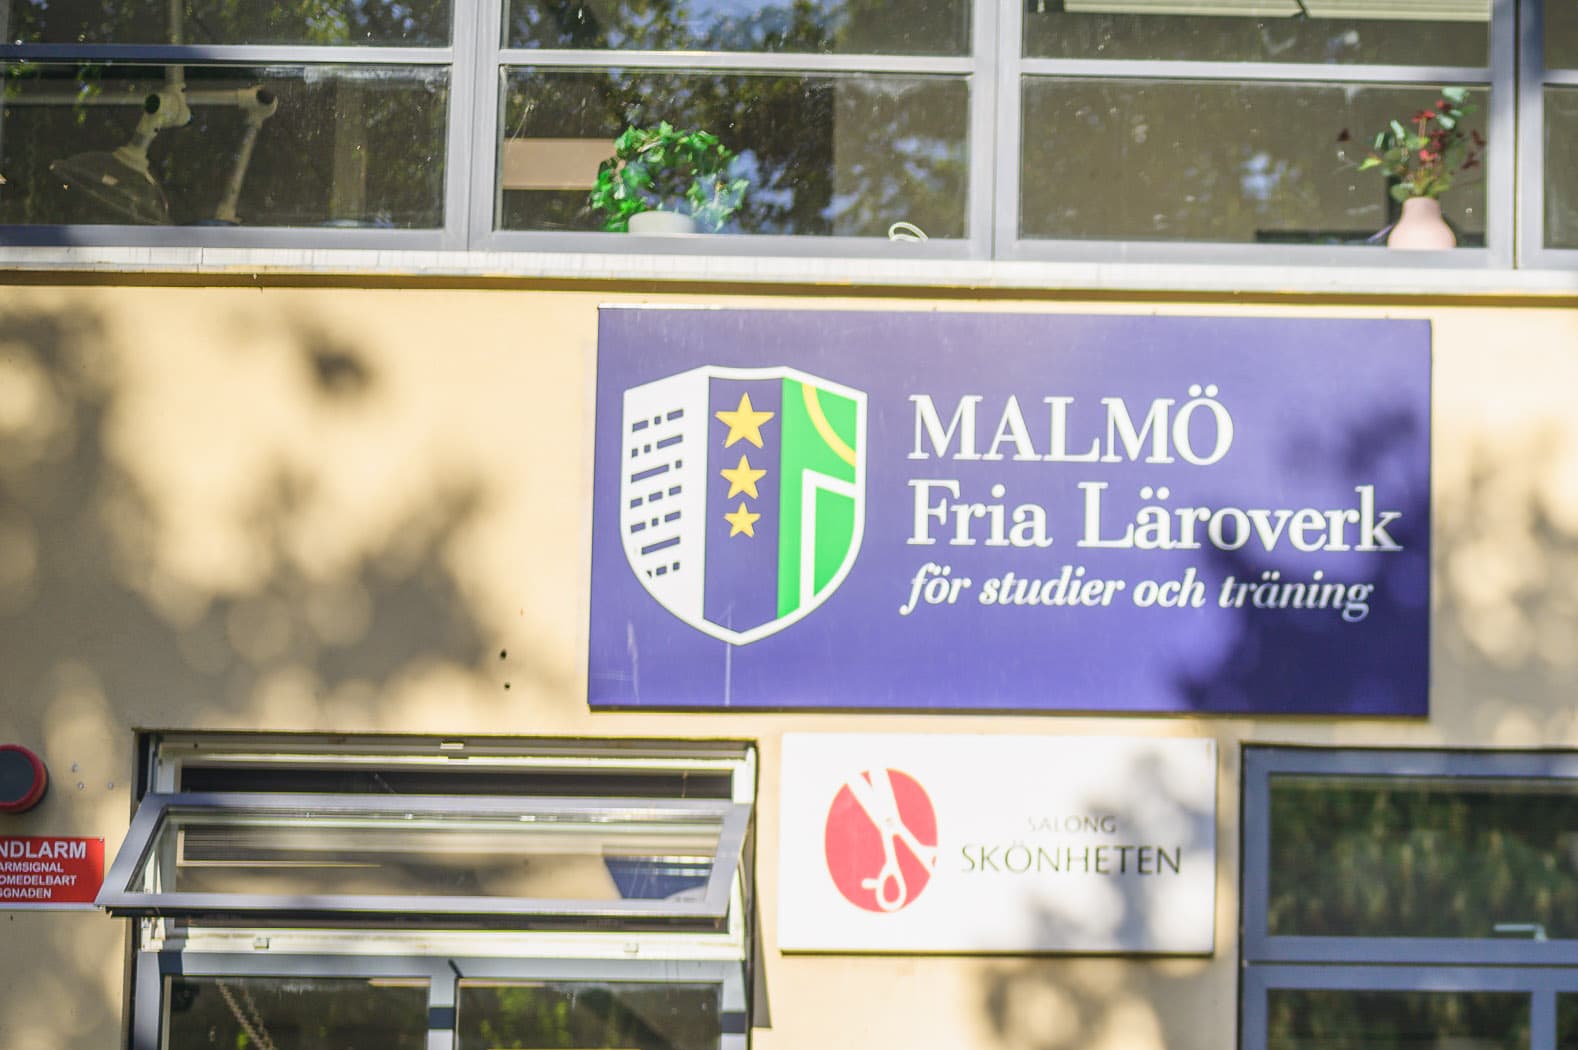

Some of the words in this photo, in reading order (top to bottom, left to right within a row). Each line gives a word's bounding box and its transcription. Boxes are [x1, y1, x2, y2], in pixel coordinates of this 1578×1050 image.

[907, 384, 1234, 466] MALMÖ
[906, 478, 1052, 550] Fria
[1077, 482, 1403, 554] Läroverk
[900, 562, 972, 616] för
[979, 566, 1125, 609] studier
[1135, 569, 1206, 609] och
[1220, 573, 1374, 622] träning
[1027, 814, 1117, 835] SALONG
[961, 841, 1183, 875] SKÖNHETEN
